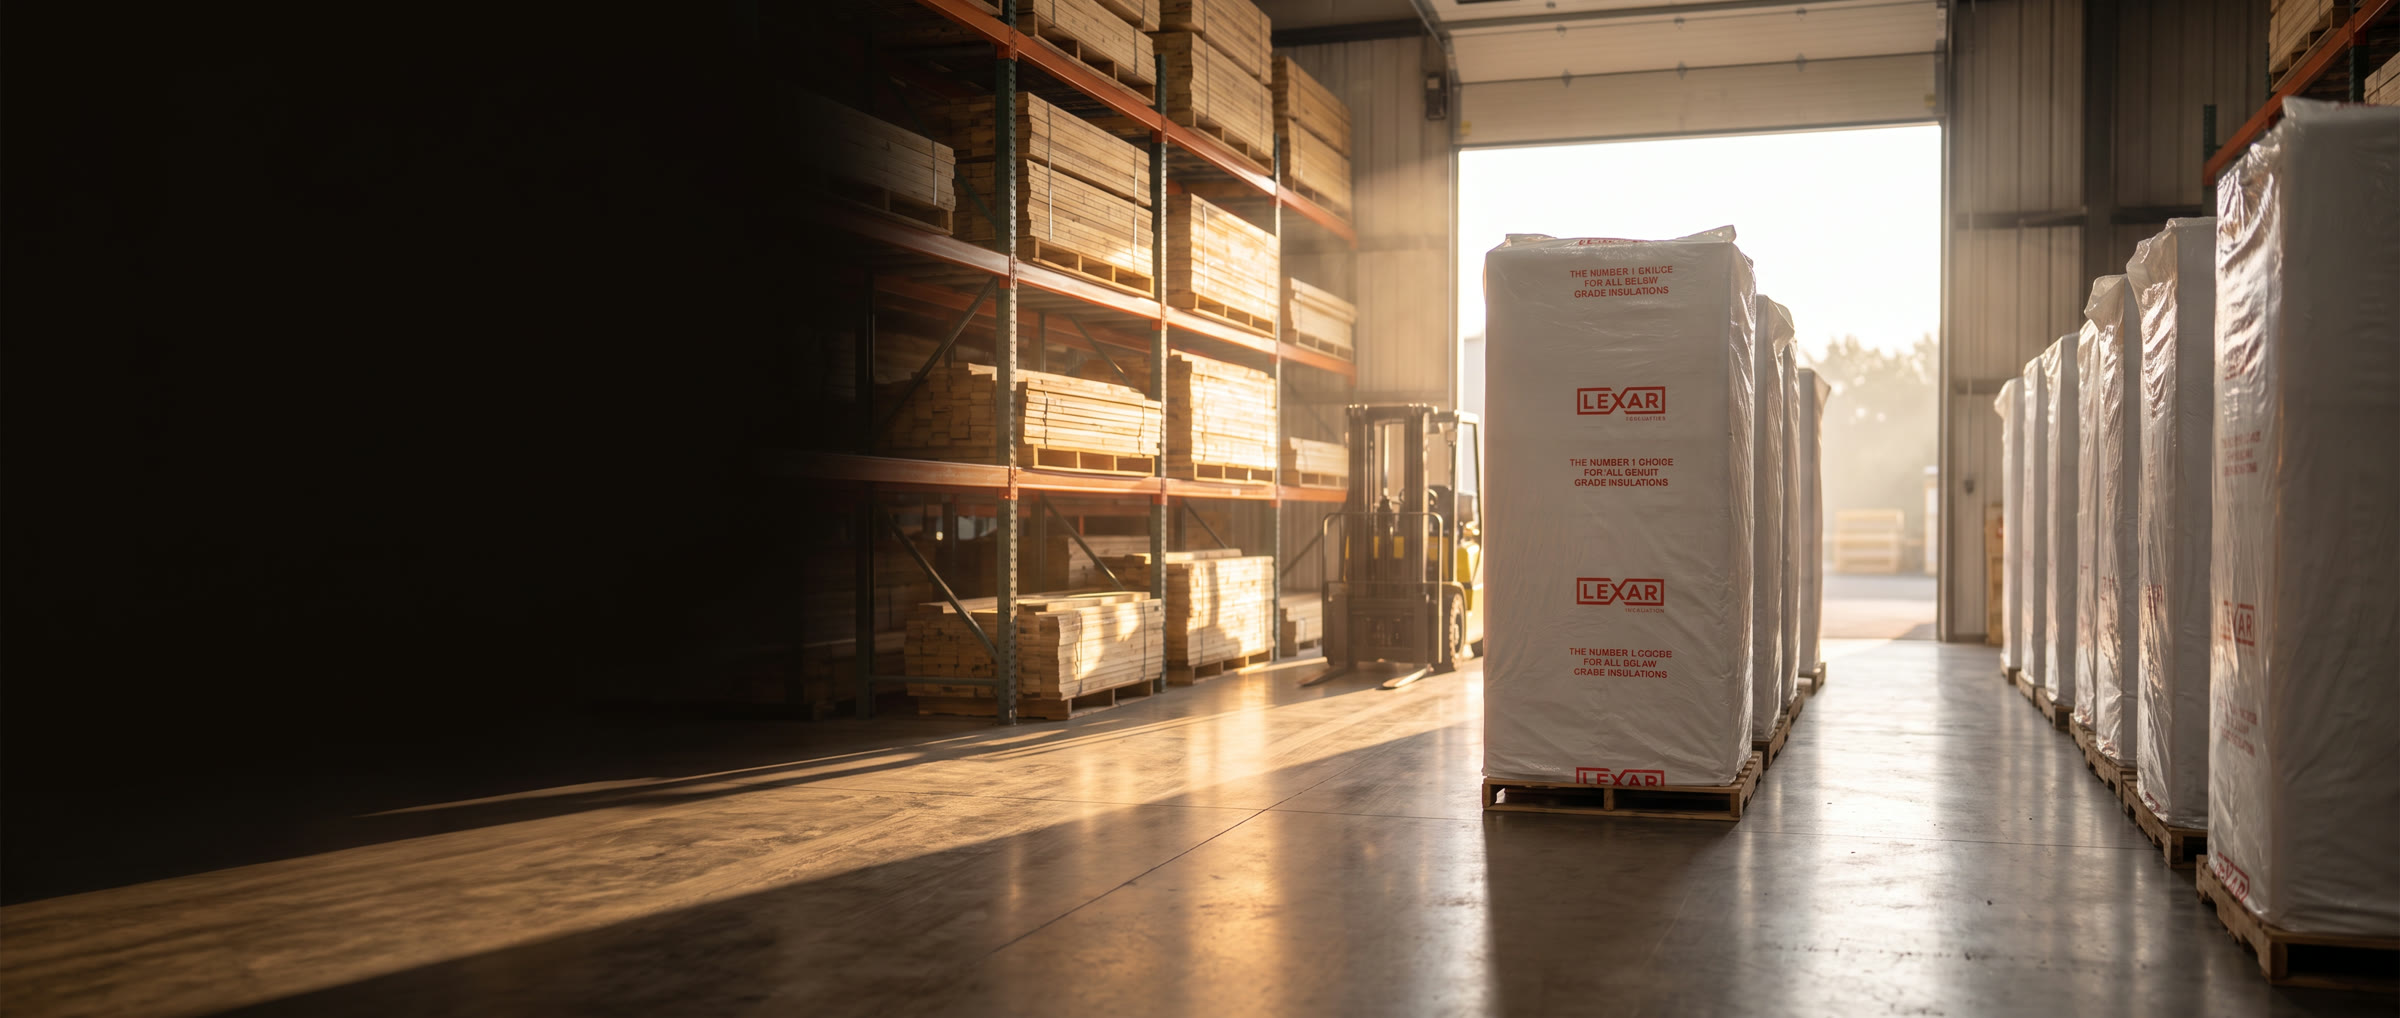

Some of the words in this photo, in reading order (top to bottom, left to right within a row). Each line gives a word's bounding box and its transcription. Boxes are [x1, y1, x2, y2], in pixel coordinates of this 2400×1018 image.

[1569, 269, 1588, 278] THE
[1590, 267, 1629, 277] NUMBER
[1584, 279, 1603, 287] FOR
[1605, 278, 1623, 286] ALL
[1574, 288, 1607, 298] GRADE
[1608, 286, 1669, 297] INSULATIONS
[1581, 391, 1662, 411] LEXAR
[1569, 458, 1588, 466] THE
[1589, 458, 1630, 467] NUMBER
[1574, 478, 1607, 487] GRADE
[1608, 478, 1669, 487] INSULATIONS
[1581, 582, 1661, 602] LEXAR
[1569, 647, 1587, 656] THE
[1589, 648, 1628, 657] NUMBER
[1583, 658, 1602, 666] FOR
[1604, 658, 1621, 667] ALL
[1607, 668, 1668, 679] INSULATIONS
